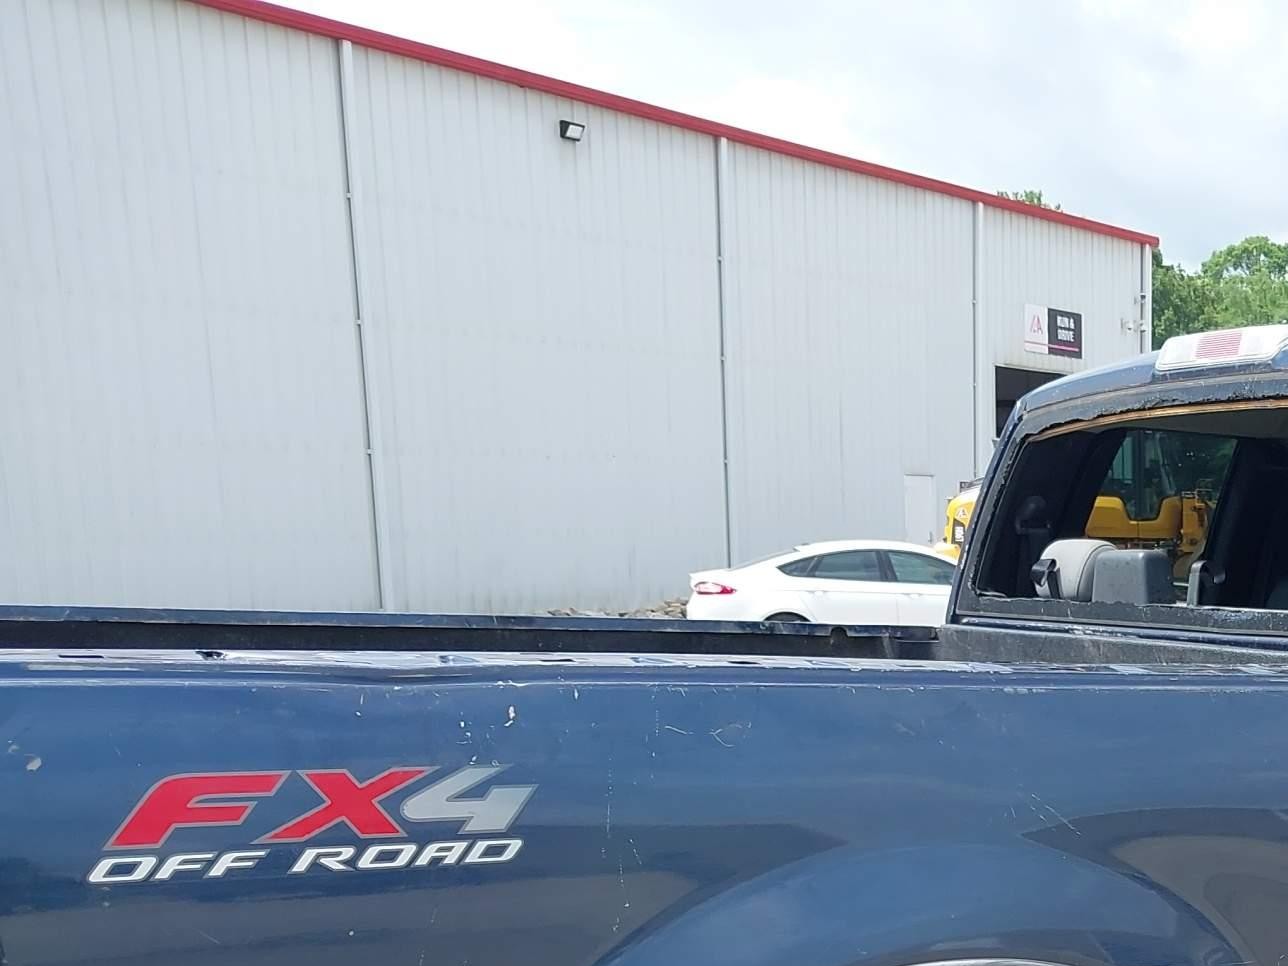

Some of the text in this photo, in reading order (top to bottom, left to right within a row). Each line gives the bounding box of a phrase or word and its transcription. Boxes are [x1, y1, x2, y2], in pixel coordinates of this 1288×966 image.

[103, 764, 539, 851] FX4
[87, 838, 525, 884] OFF ROAD
